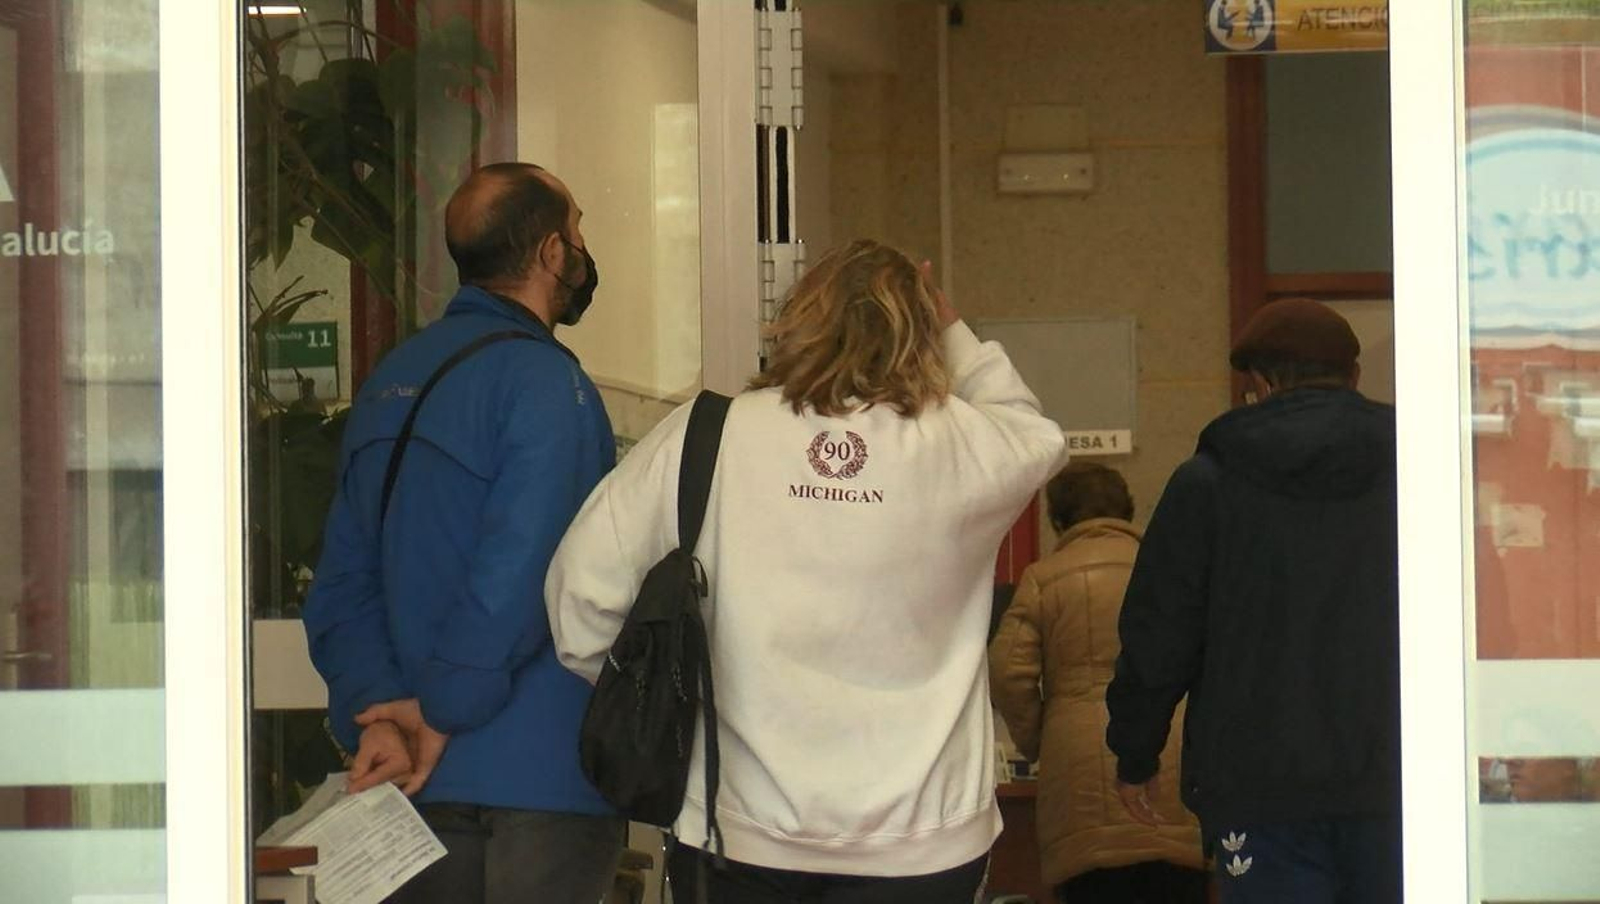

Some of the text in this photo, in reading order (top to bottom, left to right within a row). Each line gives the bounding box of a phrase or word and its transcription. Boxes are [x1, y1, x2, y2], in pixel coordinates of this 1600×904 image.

[307, 329, 331, 348] 11
[823, 441, 850, 461] 90
[1065, 434, 1118, 449] ESA 1
[788, 484, 884, 503] MICHIGAN
